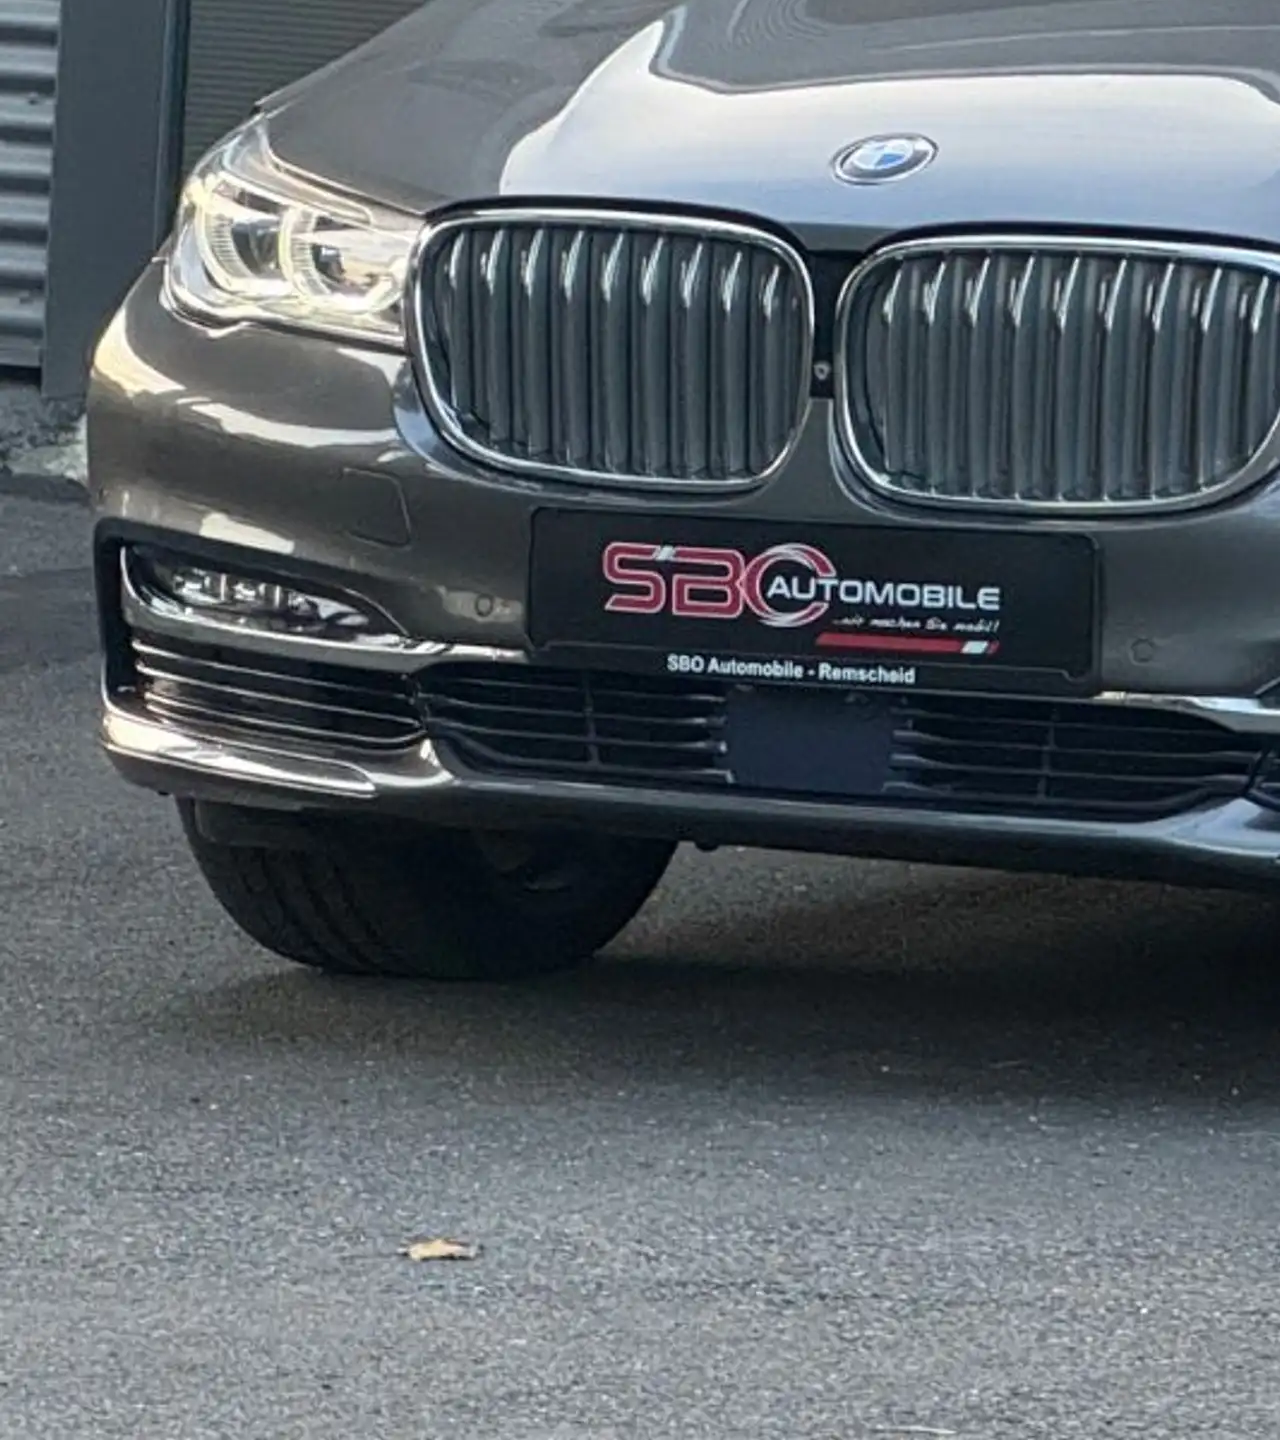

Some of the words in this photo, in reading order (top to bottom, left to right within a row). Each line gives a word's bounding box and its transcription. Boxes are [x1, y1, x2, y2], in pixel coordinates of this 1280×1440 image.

[766, 576, 1000, 610] AUTOMOBILE
[667, 653, 704, 672] SBO
[707, 656, 803, 679] Automobile
[818, 662, 916, 684] Remscheid
